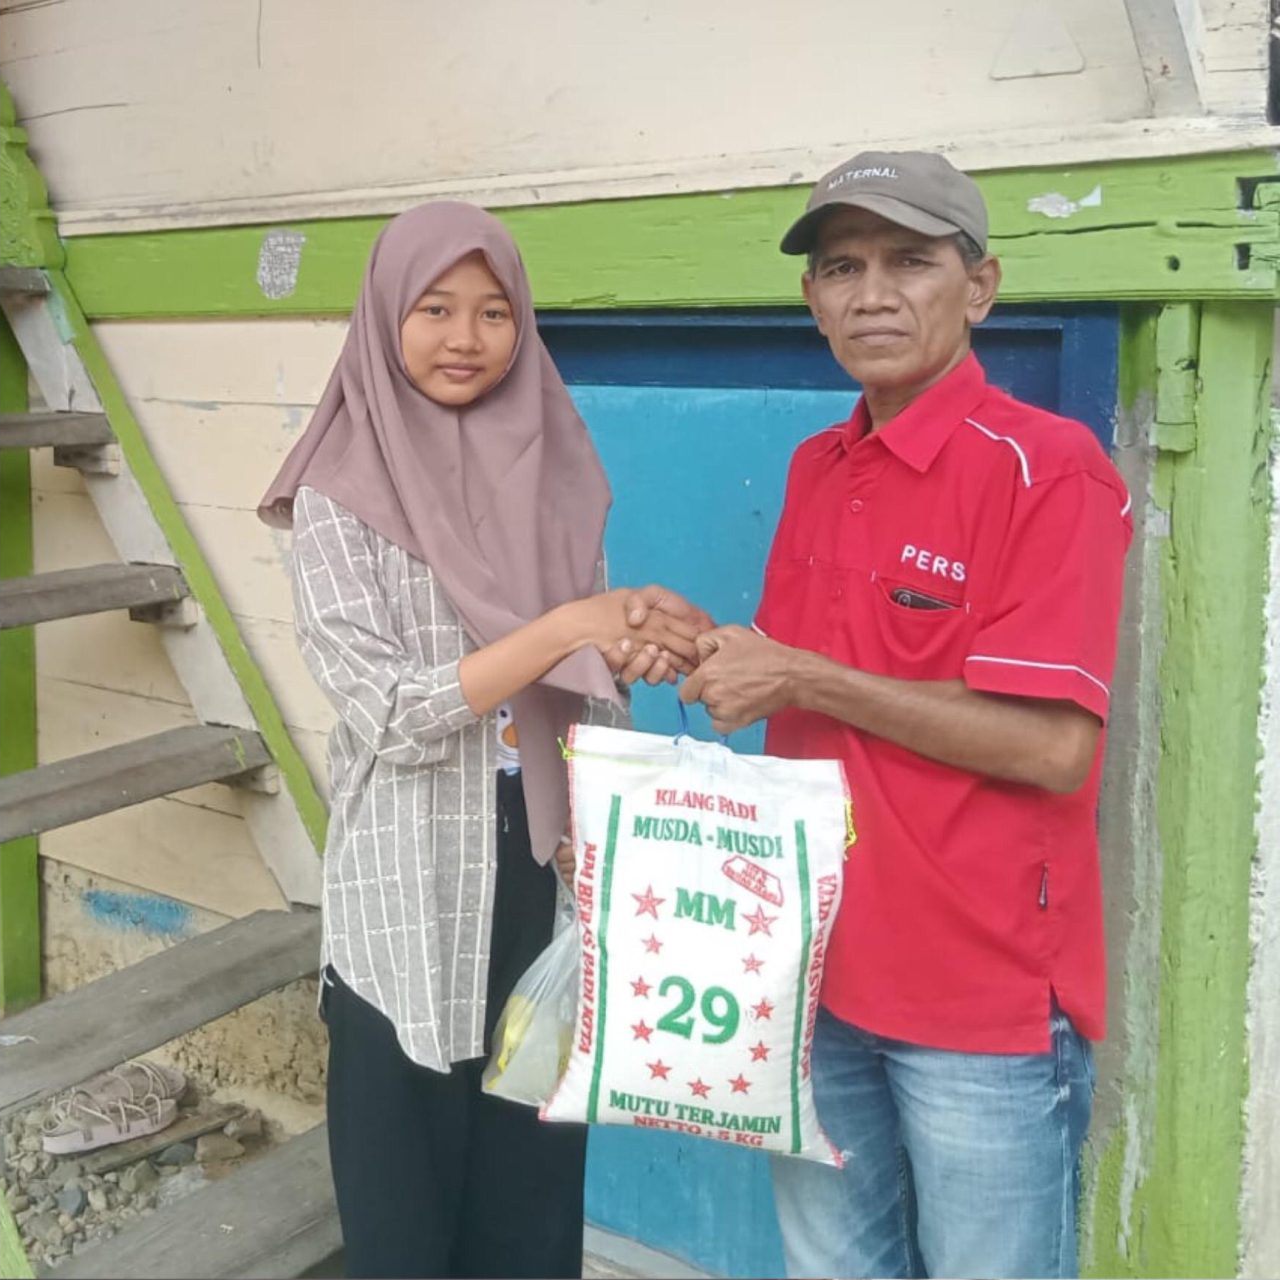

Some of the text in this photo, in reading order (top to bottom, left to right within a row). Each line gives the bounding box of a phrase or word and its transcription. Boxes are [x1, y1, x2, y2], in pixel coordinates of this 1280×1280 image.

[900, 544, 966, 581] PERS
[655, 789, 757, 821] KILANG PADI
[632, 815, 702, 845] MUSDA
[716, 827, 783, 858] MUSDI
[580, 842, 597, 879] MM
[674, 887, 736, 931] MM
[582, 951, 595, 1003] PADI
[579, 1005, 595, 1054] KITA
[656, 975, 740, 1045] 29
[609, 1090, 782, 1134] MUTU TERJAMIN
[633, 1115, 702, 1136] NETTO
[718, 1130, 730, 1141] 5
[735, 1132, 763, 1147] KG
